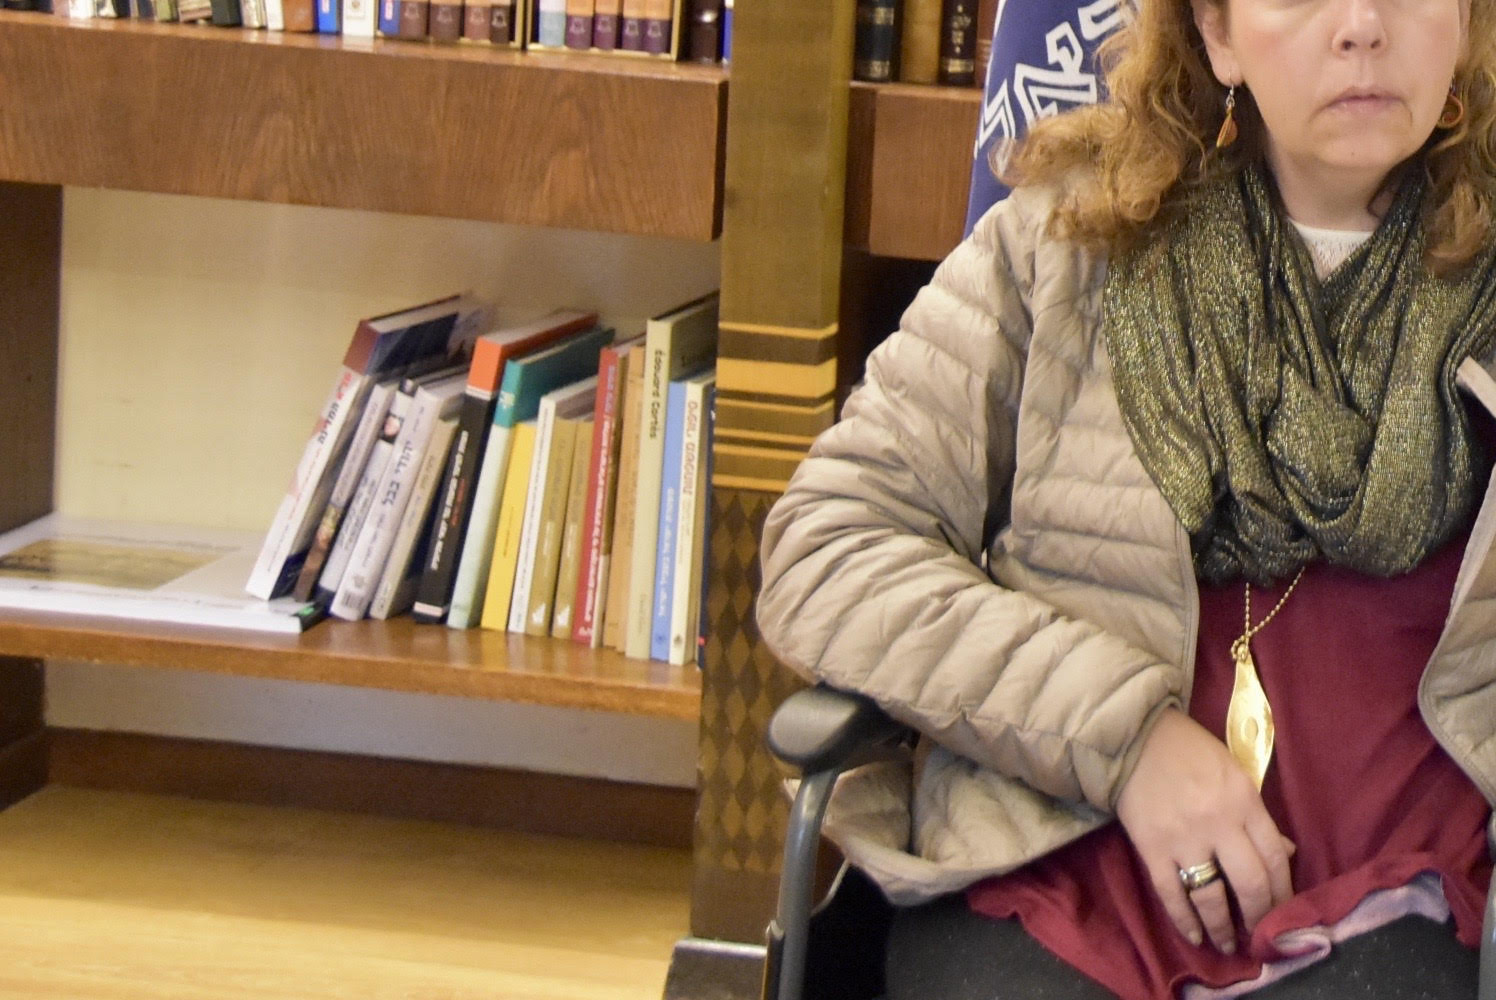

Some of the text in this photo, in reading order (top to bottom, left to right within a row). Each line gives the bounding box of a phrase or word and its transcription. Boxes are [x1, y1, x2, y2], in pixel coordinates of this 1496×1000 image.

[682, 399, 699, 495] סיפורי משפחות
[381, 481, 402, 507] בבל
